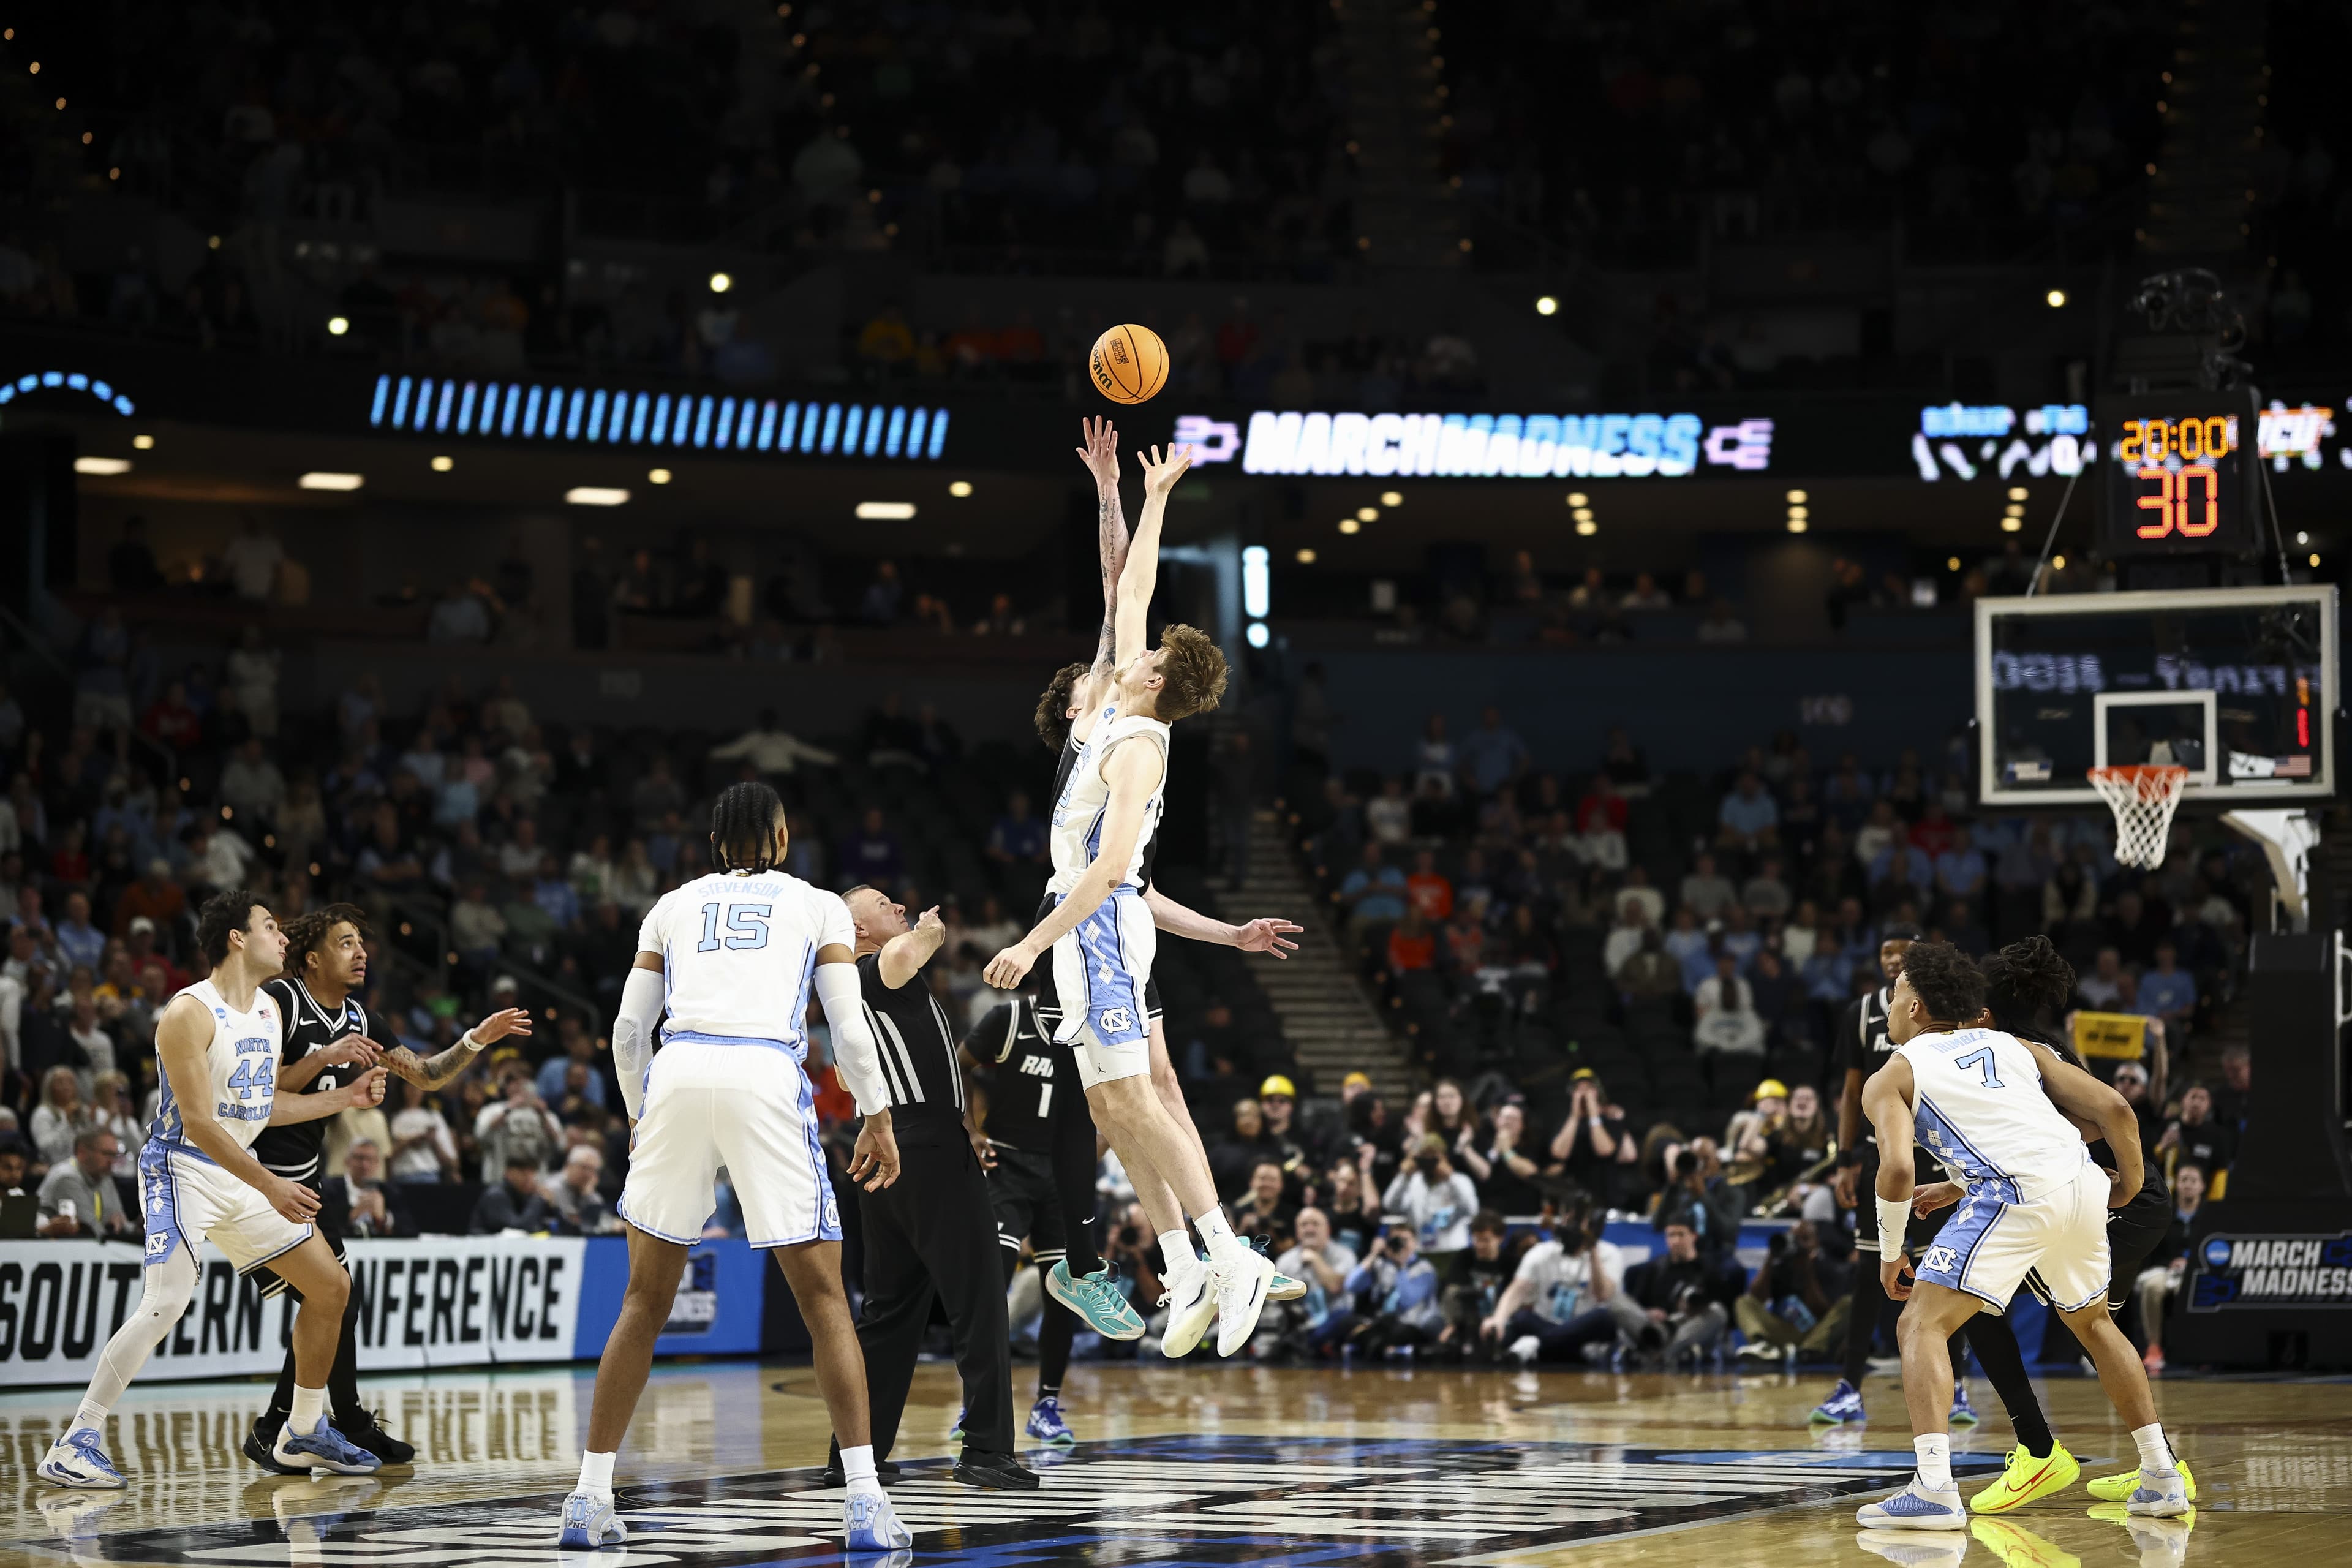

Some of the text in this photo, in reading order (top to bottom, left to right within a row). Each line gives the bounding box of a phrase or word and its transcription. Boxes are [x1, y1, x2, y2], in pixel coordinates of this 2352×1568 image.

[2120, 417, 2228, 462] 20:00
[2137, 464, 2218, 539] 30
[698, 881, 783, 899] STEVENSON
[698, 903, 772, 953] 15
[235, 1038, 271, 1057] NORTH
[1928, 1031, 1989, 1054] TRIMBLE
[228, 1058, 274, 1099] 44
[1954, 1046, 2005, 1088] 7
[218, 1102, 273, 1121] CAROLIN
[1038, 1082, 1053, 1118] 1
[2229, 1240, 2322, 1268] MARCH
[0, 1256, 565, 1362] SOUTERN NFERENCE
